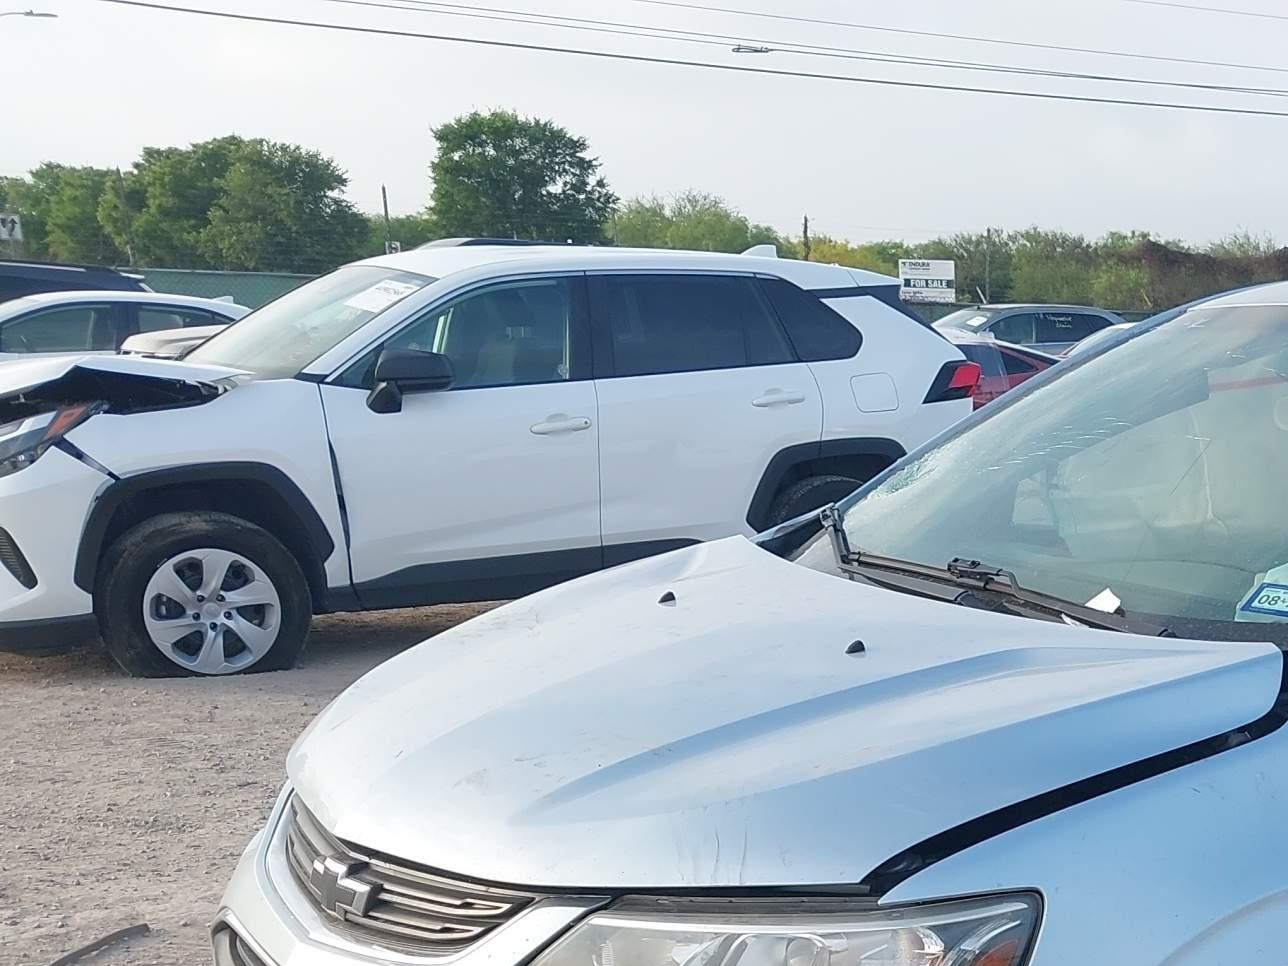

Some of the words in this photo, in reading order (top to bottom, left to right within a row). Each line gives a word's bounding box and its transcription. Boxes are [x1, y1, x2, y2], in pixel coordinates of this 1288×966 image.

[910, 279, 926, 288] FOR
[927, 279, 948, 288] SALE
[1258, 594, 1280, 606] 08
